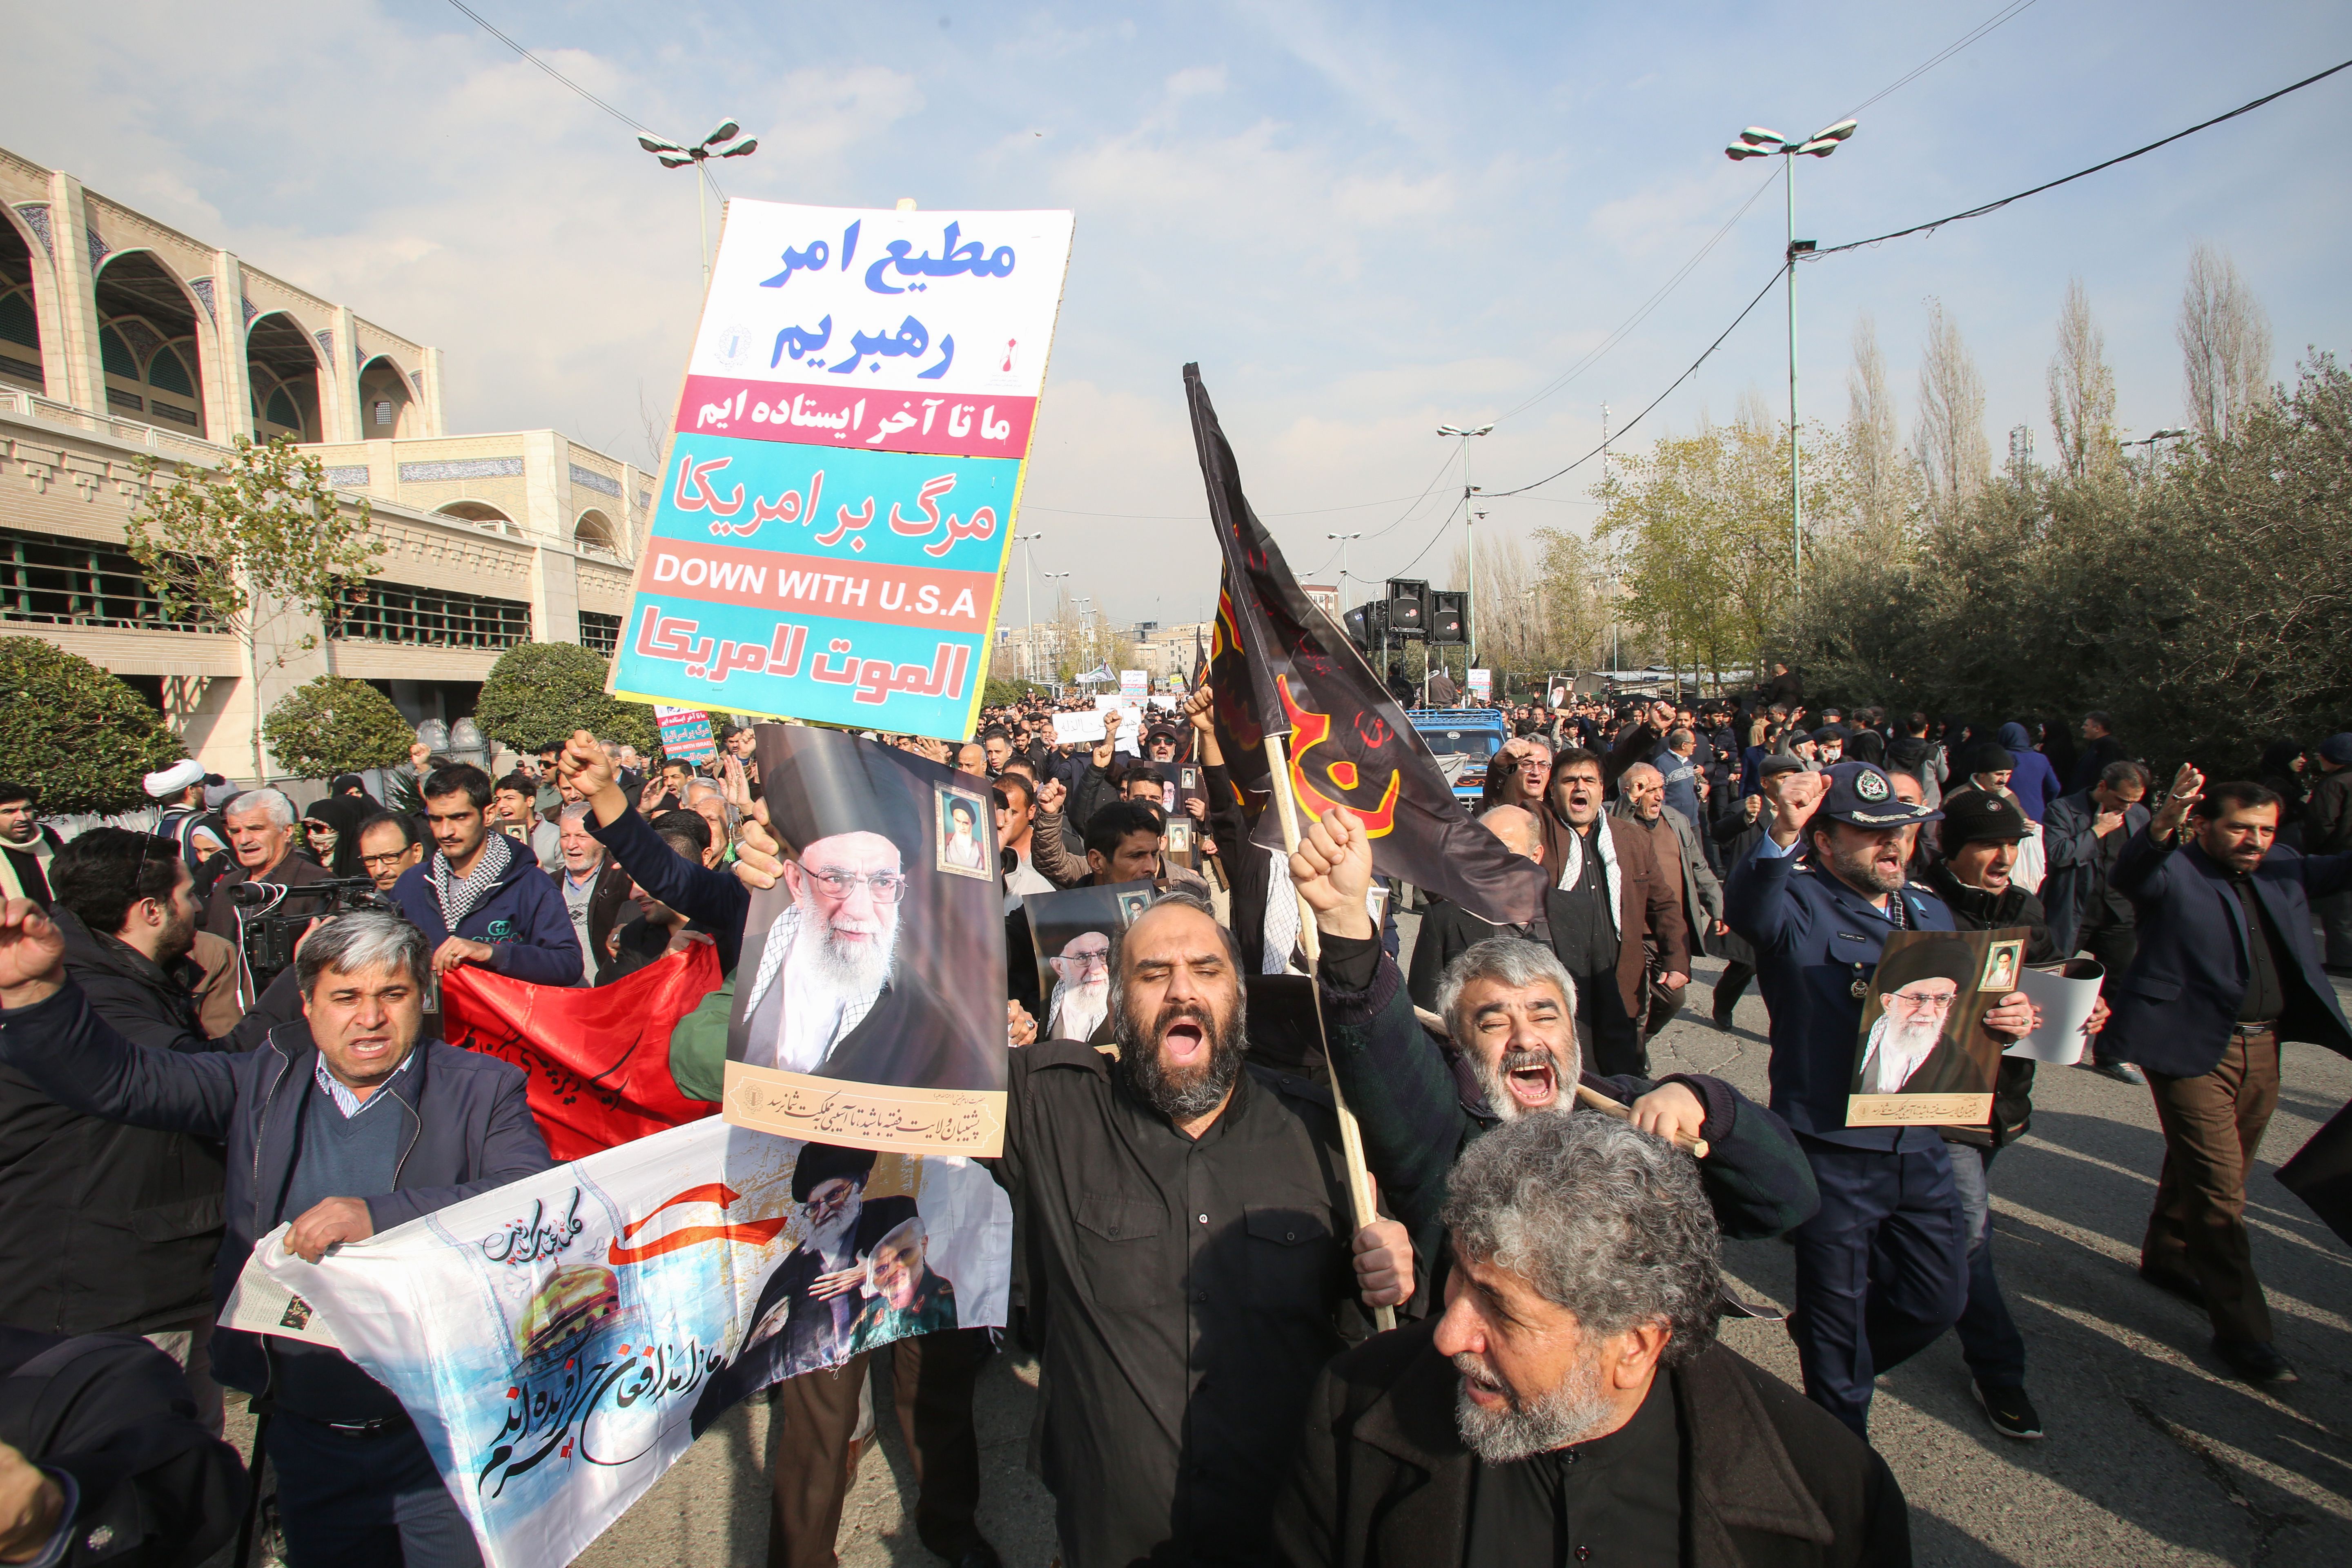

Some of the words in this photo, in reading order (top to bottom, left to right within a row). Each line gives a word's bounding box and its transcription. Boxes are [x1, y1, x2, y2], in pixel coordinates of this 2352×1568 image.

[760, 220, 861, 288] امر
[865, 220, 1016, 294] مطیع
[770, 314, 955, 379] رهبریم
[697, 389, 748, 429] ایم
[751, 393, 866, 439] ایستاده
[866, 399, 944, 444] آخر
[948, 403, 976, 438] تا
[980, 405, 1010, 440] ما
[673, 453, 825, 537] امریکا
[815, 495, 876, 553] بر
[889, 472, 997, 558] مرگ
[653, 553, 767, 594] DOWN
[779, 569, 870, 607] WITH
[879, 581, 976, 619] U.S.A
[810, 638, 971, 706] الموت
[687, 713, 696, 722] آخر
[688, 730, 696, 739] بر
[695, 724, 710, 737] مرگ
[1120, 712, 1138, 731] هیها
[663, 728, 688, 743] اسرائیل
[784, 1089, 842, 1118] مملکت
[821, 1105, 857, 1132] آسیبی
[850, 1109, 864, 1126] تا
[882, 1109, 902, 1137] فقیه
[941, 1109, 980, 1142] پشتیبان
